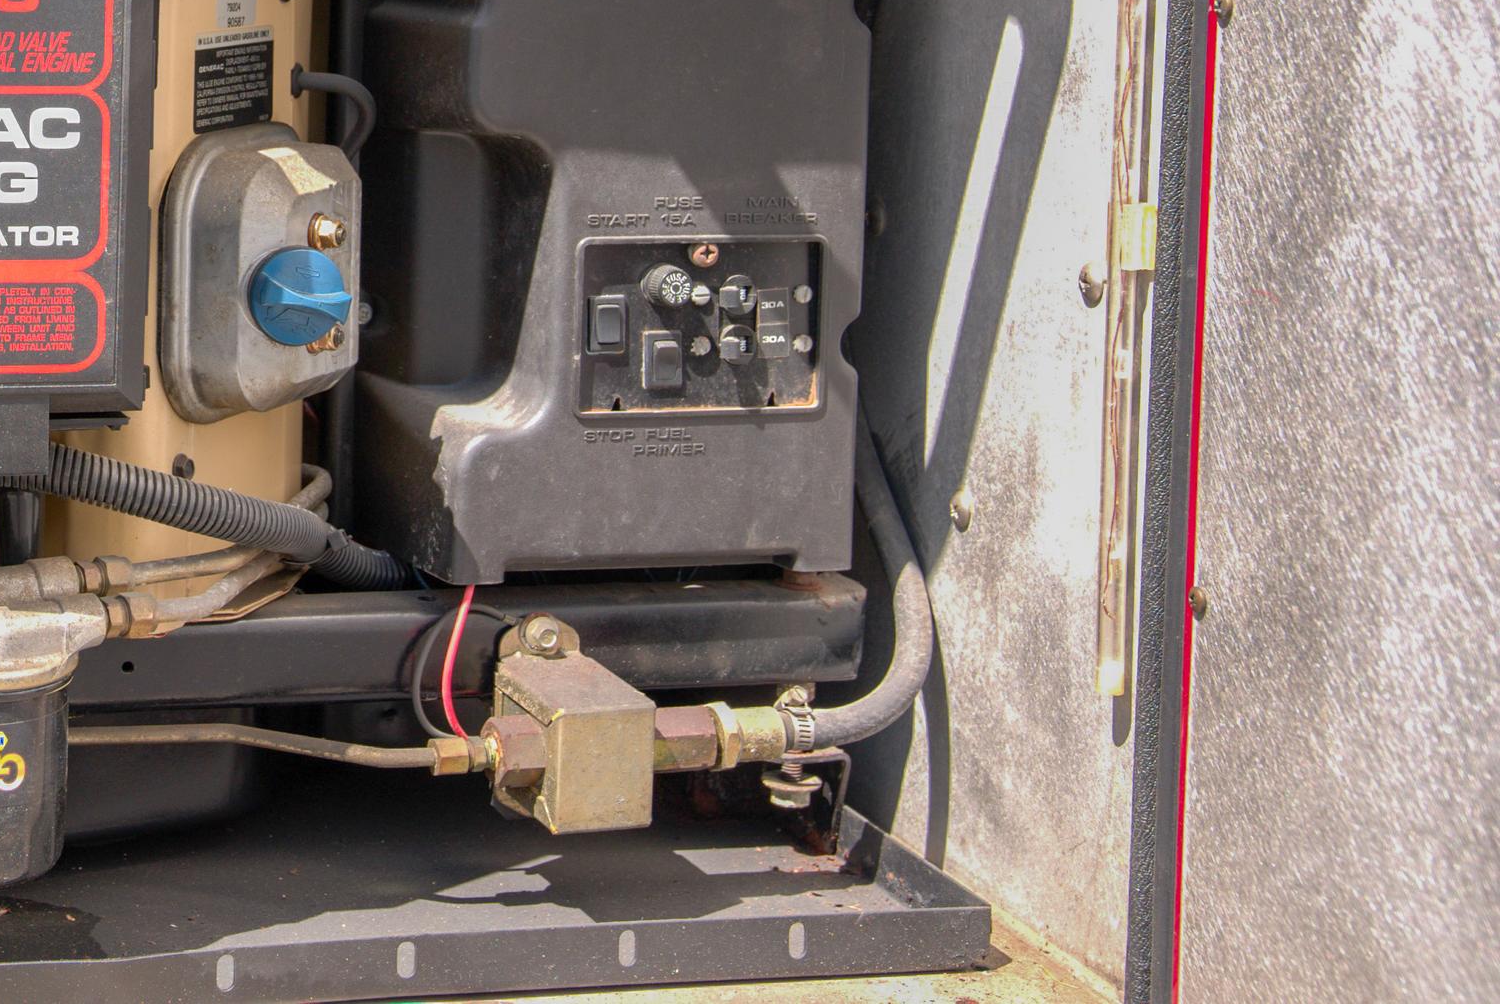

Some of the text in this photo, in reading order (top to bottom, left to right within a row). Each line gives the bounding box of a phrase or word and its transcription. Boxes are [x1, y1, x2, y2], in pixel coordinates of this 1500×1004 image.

[18, 31, 73, 52] VALVE
[21, 52, 96, 73] ENGINE
[654, 196, 703, 211] FUSE
[747, 196, 799, 208] MAIN
[587, 213, 650, 228] START
[660, 213, 698, 228] 15A
[724, 212, 819, 226] BREAKER
[666, 272, 687, 284] FUSE
[3, 306, 16, 315] AS
[19, 305, 62, 314] OUTLINED
[761, 301, 785, 310] 30A
[14, 315, 41, 324] FROM
[46, 314, 75, 323] LIVING
[55, 324, 76, 332] AND
[0, 333, 11, 342] TO
[761, 335, 786, 344] 30A
[584, 428, 692, 444] STOP FUEL
[633, 443, 706, 457] PRIMER
